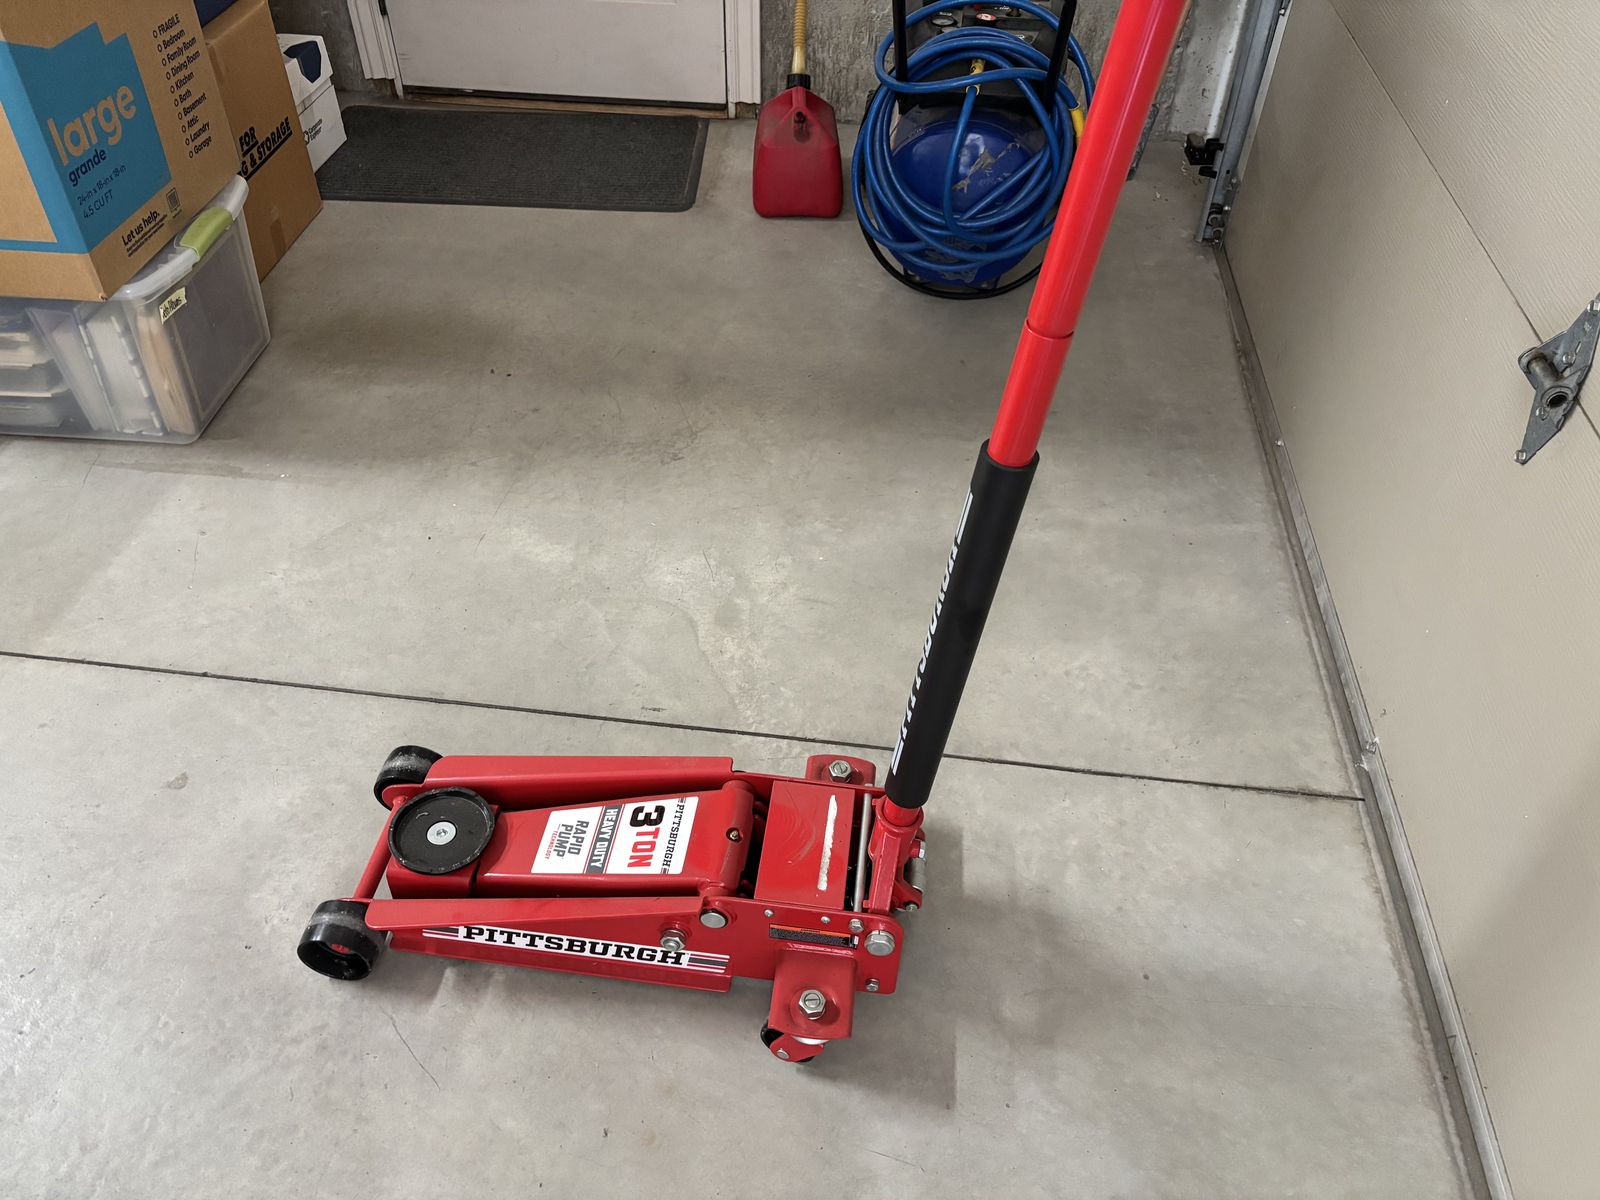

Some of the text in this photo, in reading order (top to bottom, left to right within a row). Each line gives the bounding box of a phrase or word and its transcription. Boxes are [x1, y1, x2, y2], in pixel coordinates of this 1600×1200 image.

[158, 13, 180, 35] FRAGILE
[162, 29, 185, 49] Bedroom
[167, 37, 197, 63] Family Room
[171, 50, 200, 77] Dining Room
[175, 72, 194, 89] Kitchen
[179, 88, 192, 103] Bath
[183, 92, 207, 116] Basement
[47, 85, 137, 166] large
[187, 115, 199, 129] Attic
[190, 121, 209, 142] Laundry
[194, 136, 212, 154] Garage
[239, 126, 256, 152] FOR
[249, 152, 257, 169] &
[257, 116, 291, 160] STORAGE
[68, 148, 107, 187] grande
[84, 189, 112, 218] 4.5 CU FT
[121, 229, 135, 246] Let
[134, 223, 144, 236] us
[142, 210, 160, 229] help.
[544, 830, 557, 860] TECHNOLOGY
[553, 823, 574, 858] PUMP
[567, 820, 590, 855] RAPID
[591, 808, 619, 868] HEAVY DUTY
[627, 805, 666, 868] 3 TON
[662, 803, 685, 868] PITTSBURGH
[462, 925, 686, 966] PITTSBURGH
